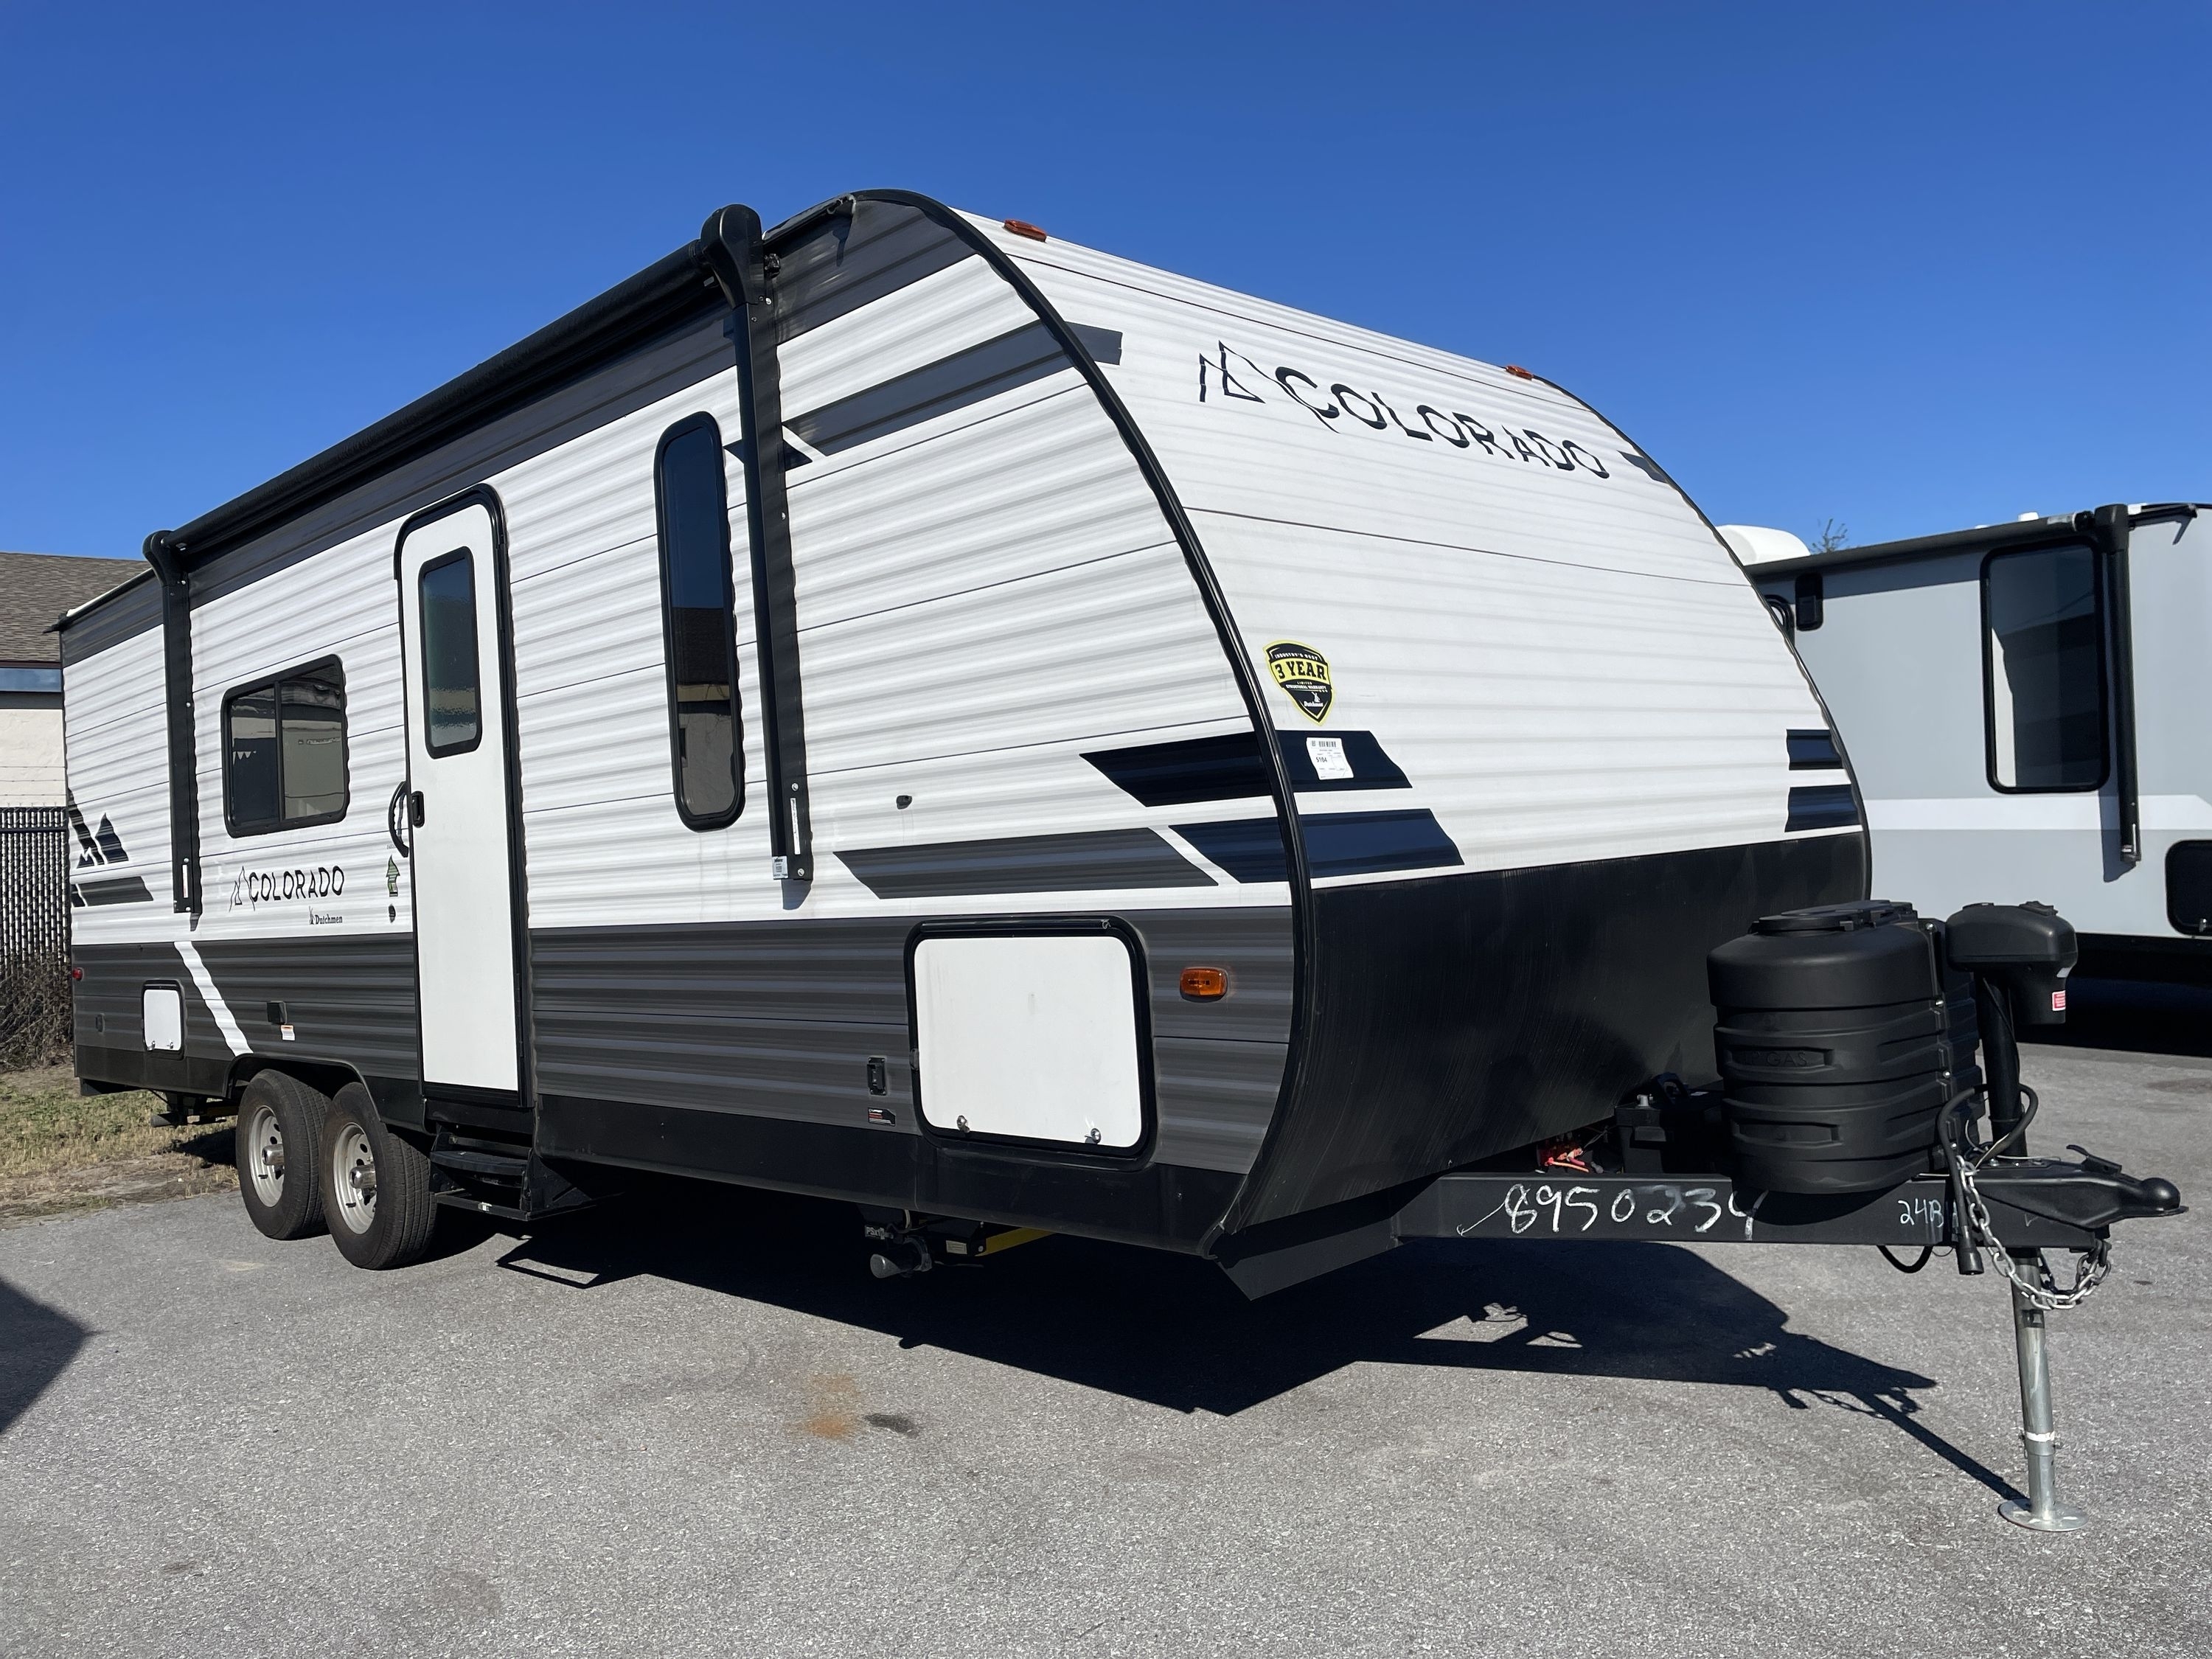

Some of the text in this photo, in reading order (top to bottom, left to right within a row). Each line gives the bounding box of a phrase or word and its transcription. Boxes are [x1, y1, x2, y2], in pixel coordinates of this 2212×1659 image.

[1274, 366, 1610, 479] COLORADO
[1274, 661, 1326, 681] 3 YEAR
[248, 865, 345, 902] COLORADO
[314, 914, 343, 925] Dutchmen
